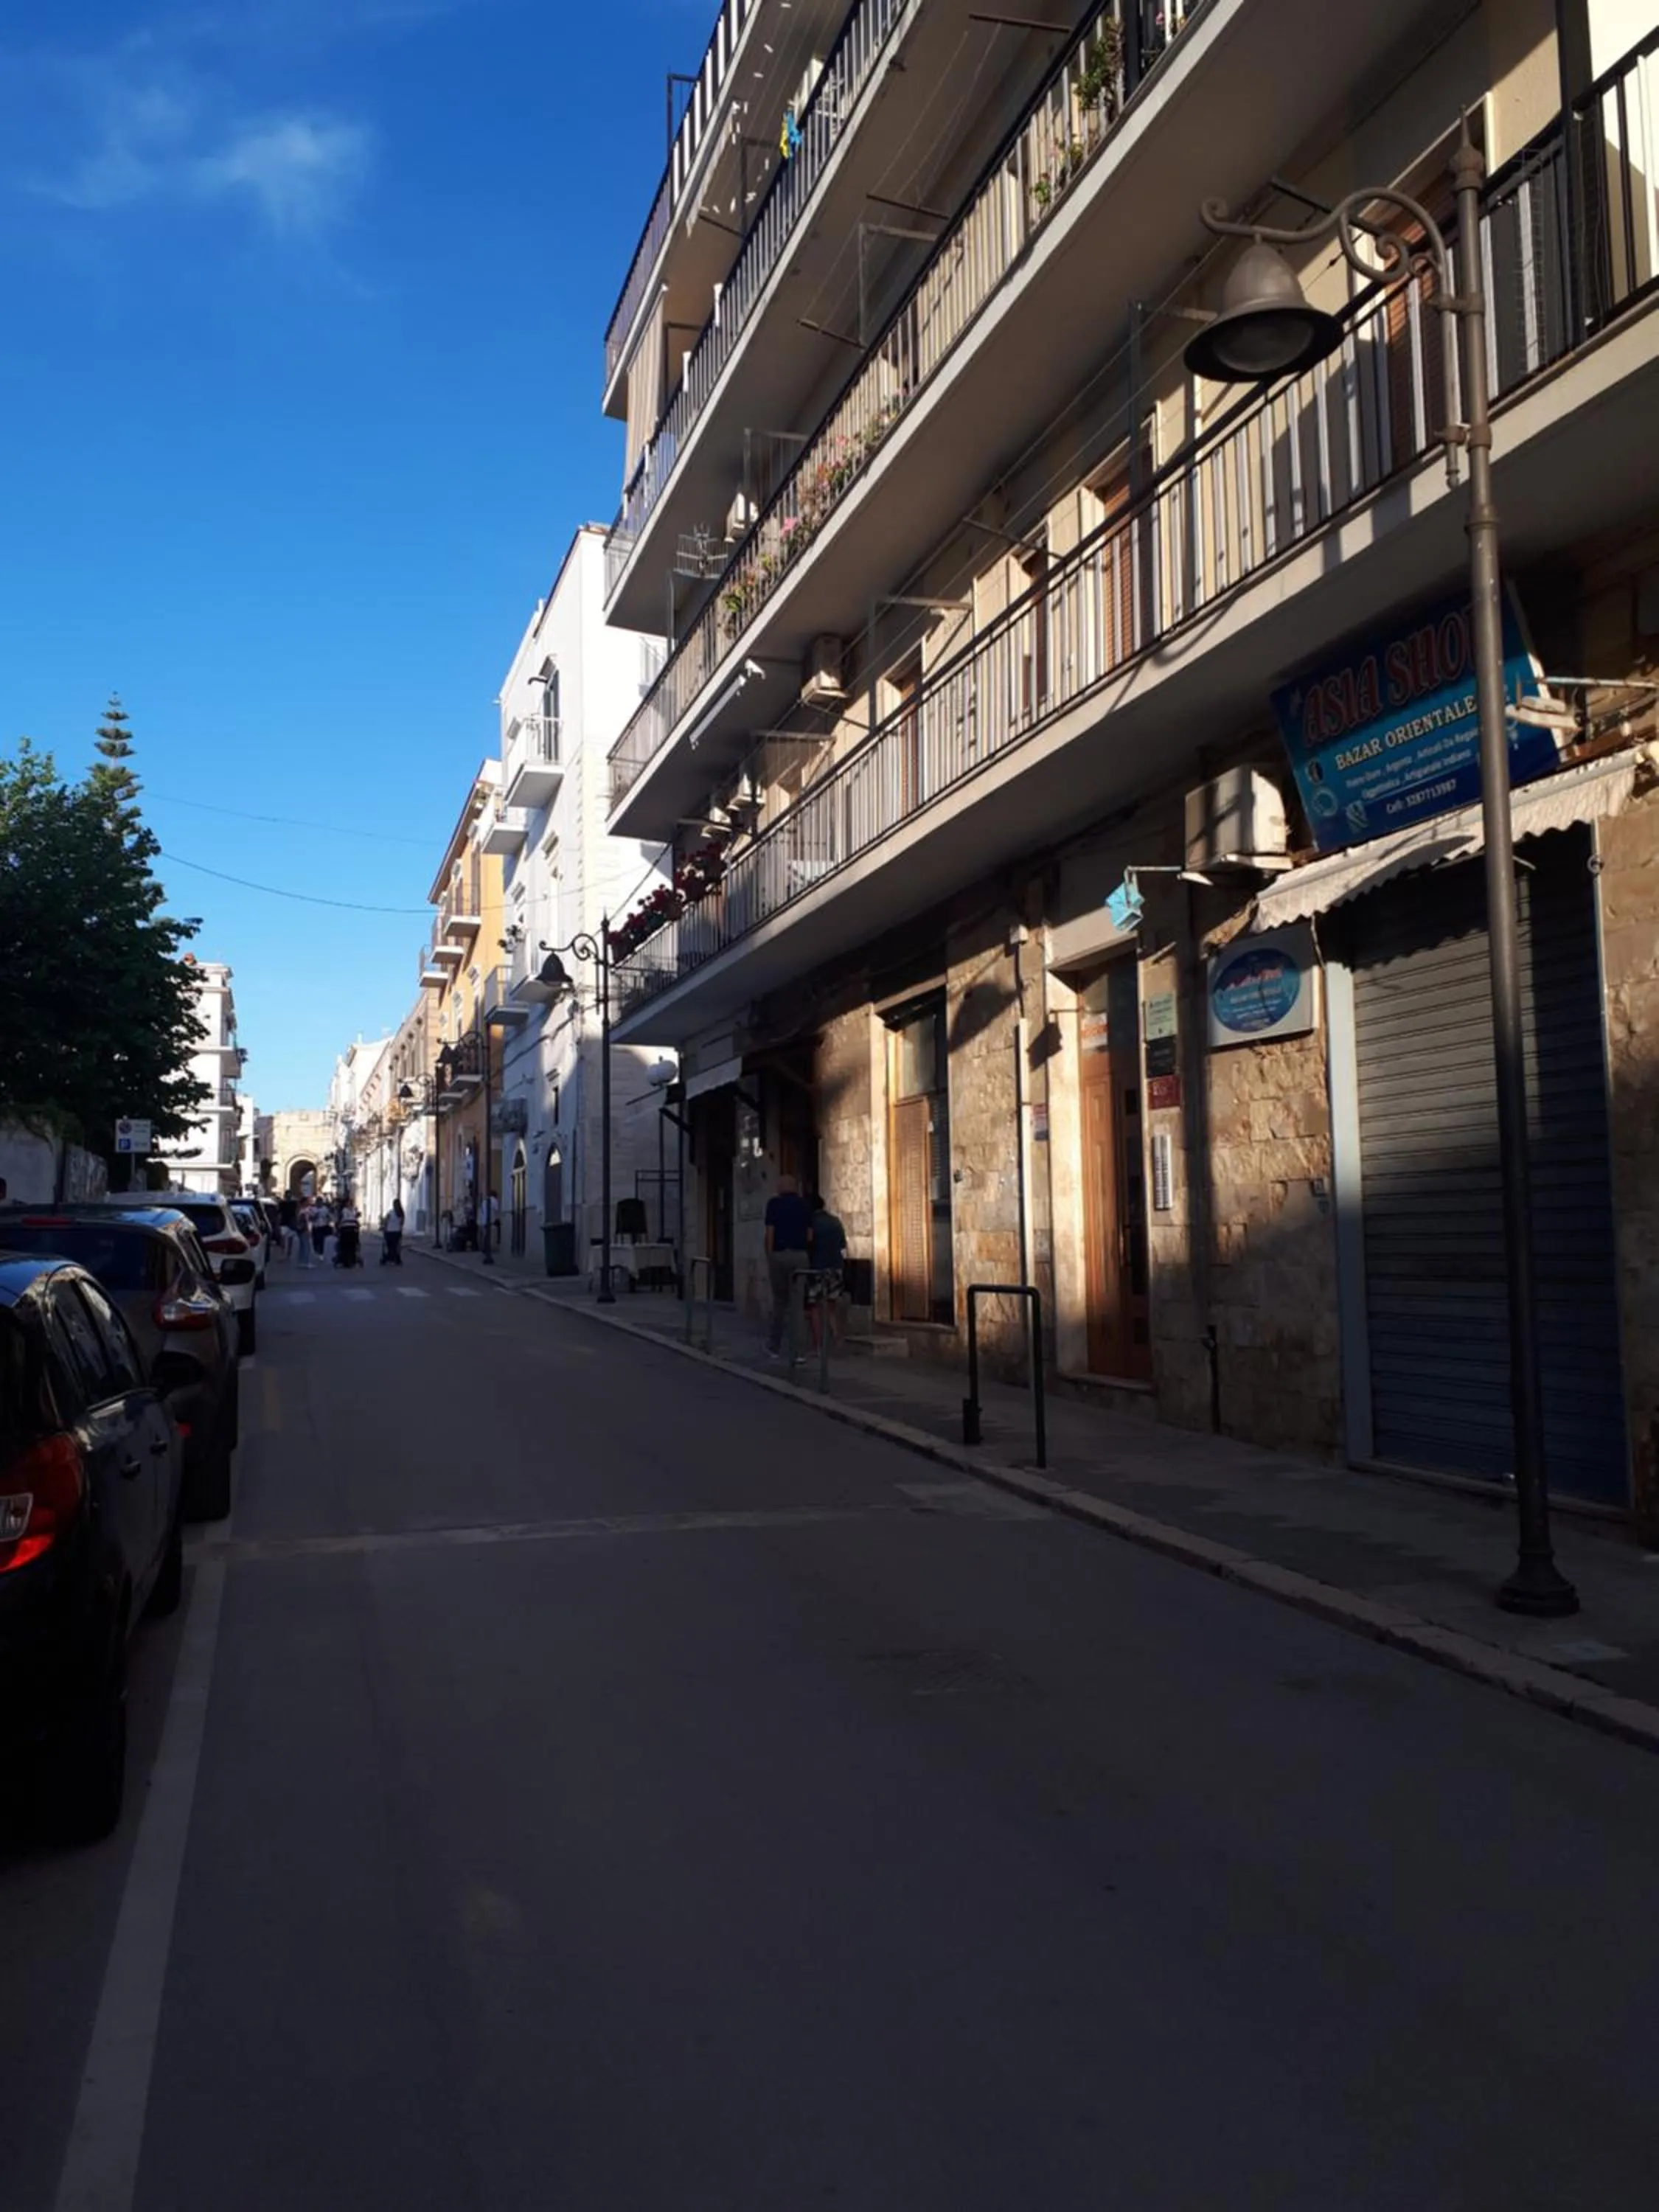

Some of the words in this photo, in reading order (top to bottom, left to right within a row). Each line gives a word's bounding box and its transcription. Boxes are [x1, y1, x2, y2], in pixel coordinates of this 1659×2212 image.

[1305, 655, 1382, 745] ASIA
[1335, 738, 1383, 771] BAZAR
[1385, 695, 1477, 748] ORIENTALE
